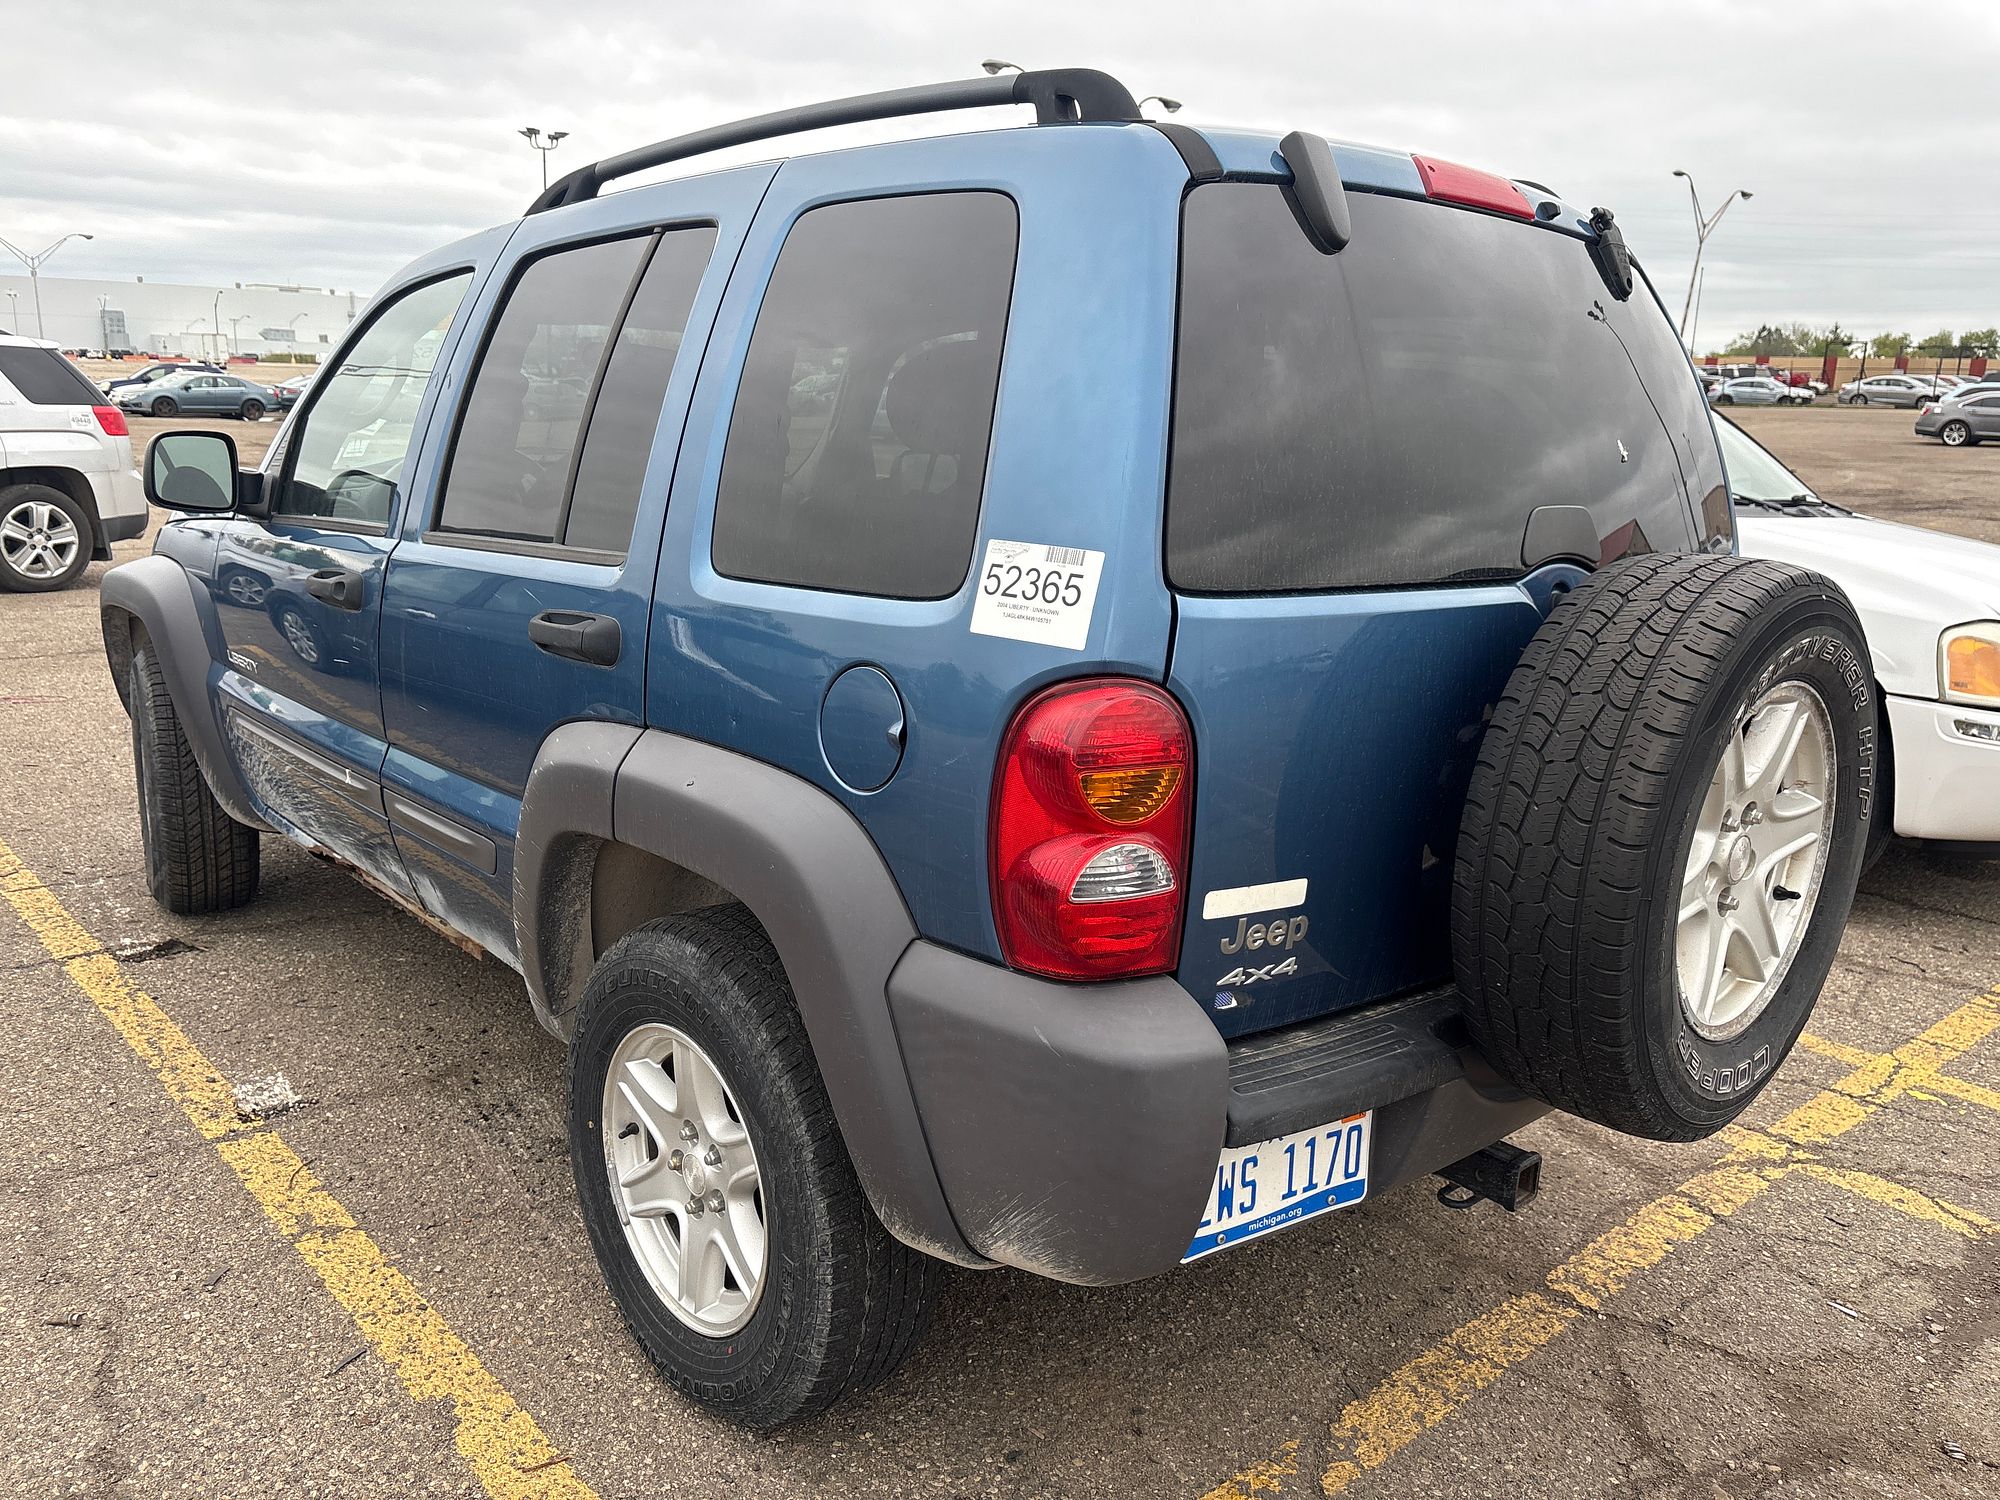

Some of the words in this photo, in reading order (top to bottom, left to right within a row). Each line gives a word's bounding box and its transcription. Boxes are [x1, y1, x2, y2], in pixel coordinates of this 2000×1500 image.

[984, 563, 1084, 607] 52365
[1008, 603, 1030, 612] LIBERTY
[1032, 607, 1060, 616] UNKNOWN
[226, 649, 258, 674] LIBERTY
[1220, 915, 1309, 955] Jeep
[592, 967, 712, 1025] MOUNTAIN
[1678, 1024, 1770, 1094] COOPER
[1201, 1154, 1259, 1229] WS
[1281, 1124, 1363, 1201] 1170
[1248, 1206, 1302, 1232] michigan.org
